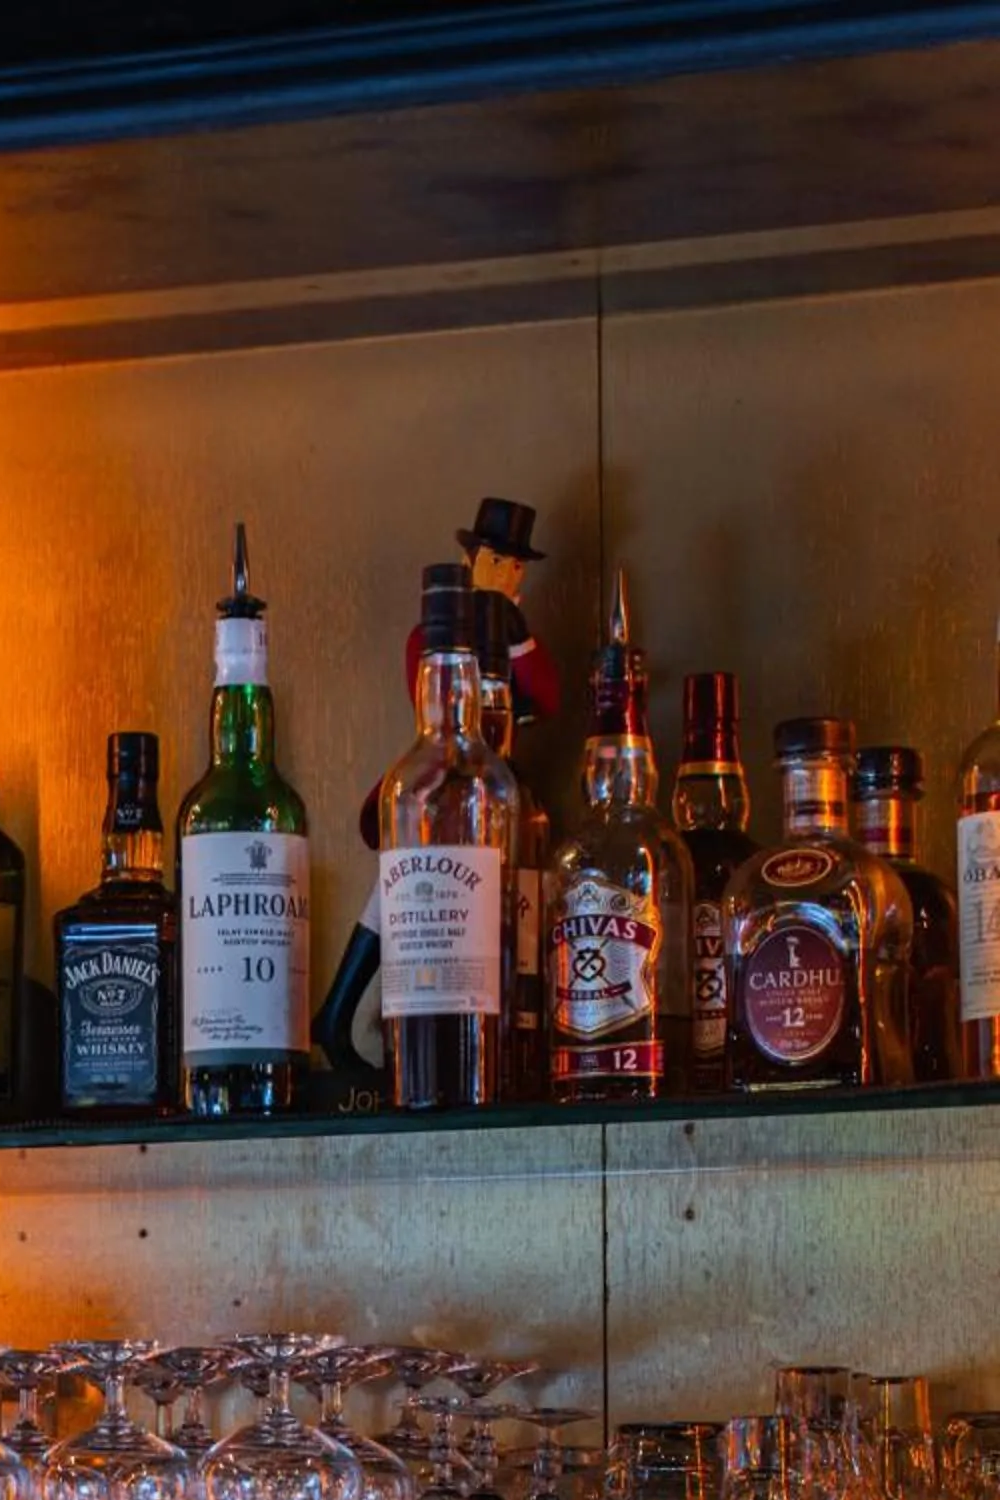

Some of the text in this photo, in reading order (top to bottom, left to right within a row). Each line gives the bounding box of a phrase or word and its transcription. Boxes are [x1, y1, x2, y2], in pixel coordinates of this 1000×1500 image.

[384, 855, 483, 896] ABERLOUR
[963, 868, 1000, 882] OBA
[188, 892, 310, 920] LAPHROAI
[388, 908, 470, 926] DISTILLERY
[552, 916, 638, 944] CHIVAS
[64, 951, 161, 990] JACK DANIEL'S
[242, 956, 276, 982] 10
[749, 968, 841, 991] CARDHU
[782, 1007, 805, 1027] 12
[76, 1042, 148, 1056] WHISKEY
[613, 1049, 637, 1070] 12
